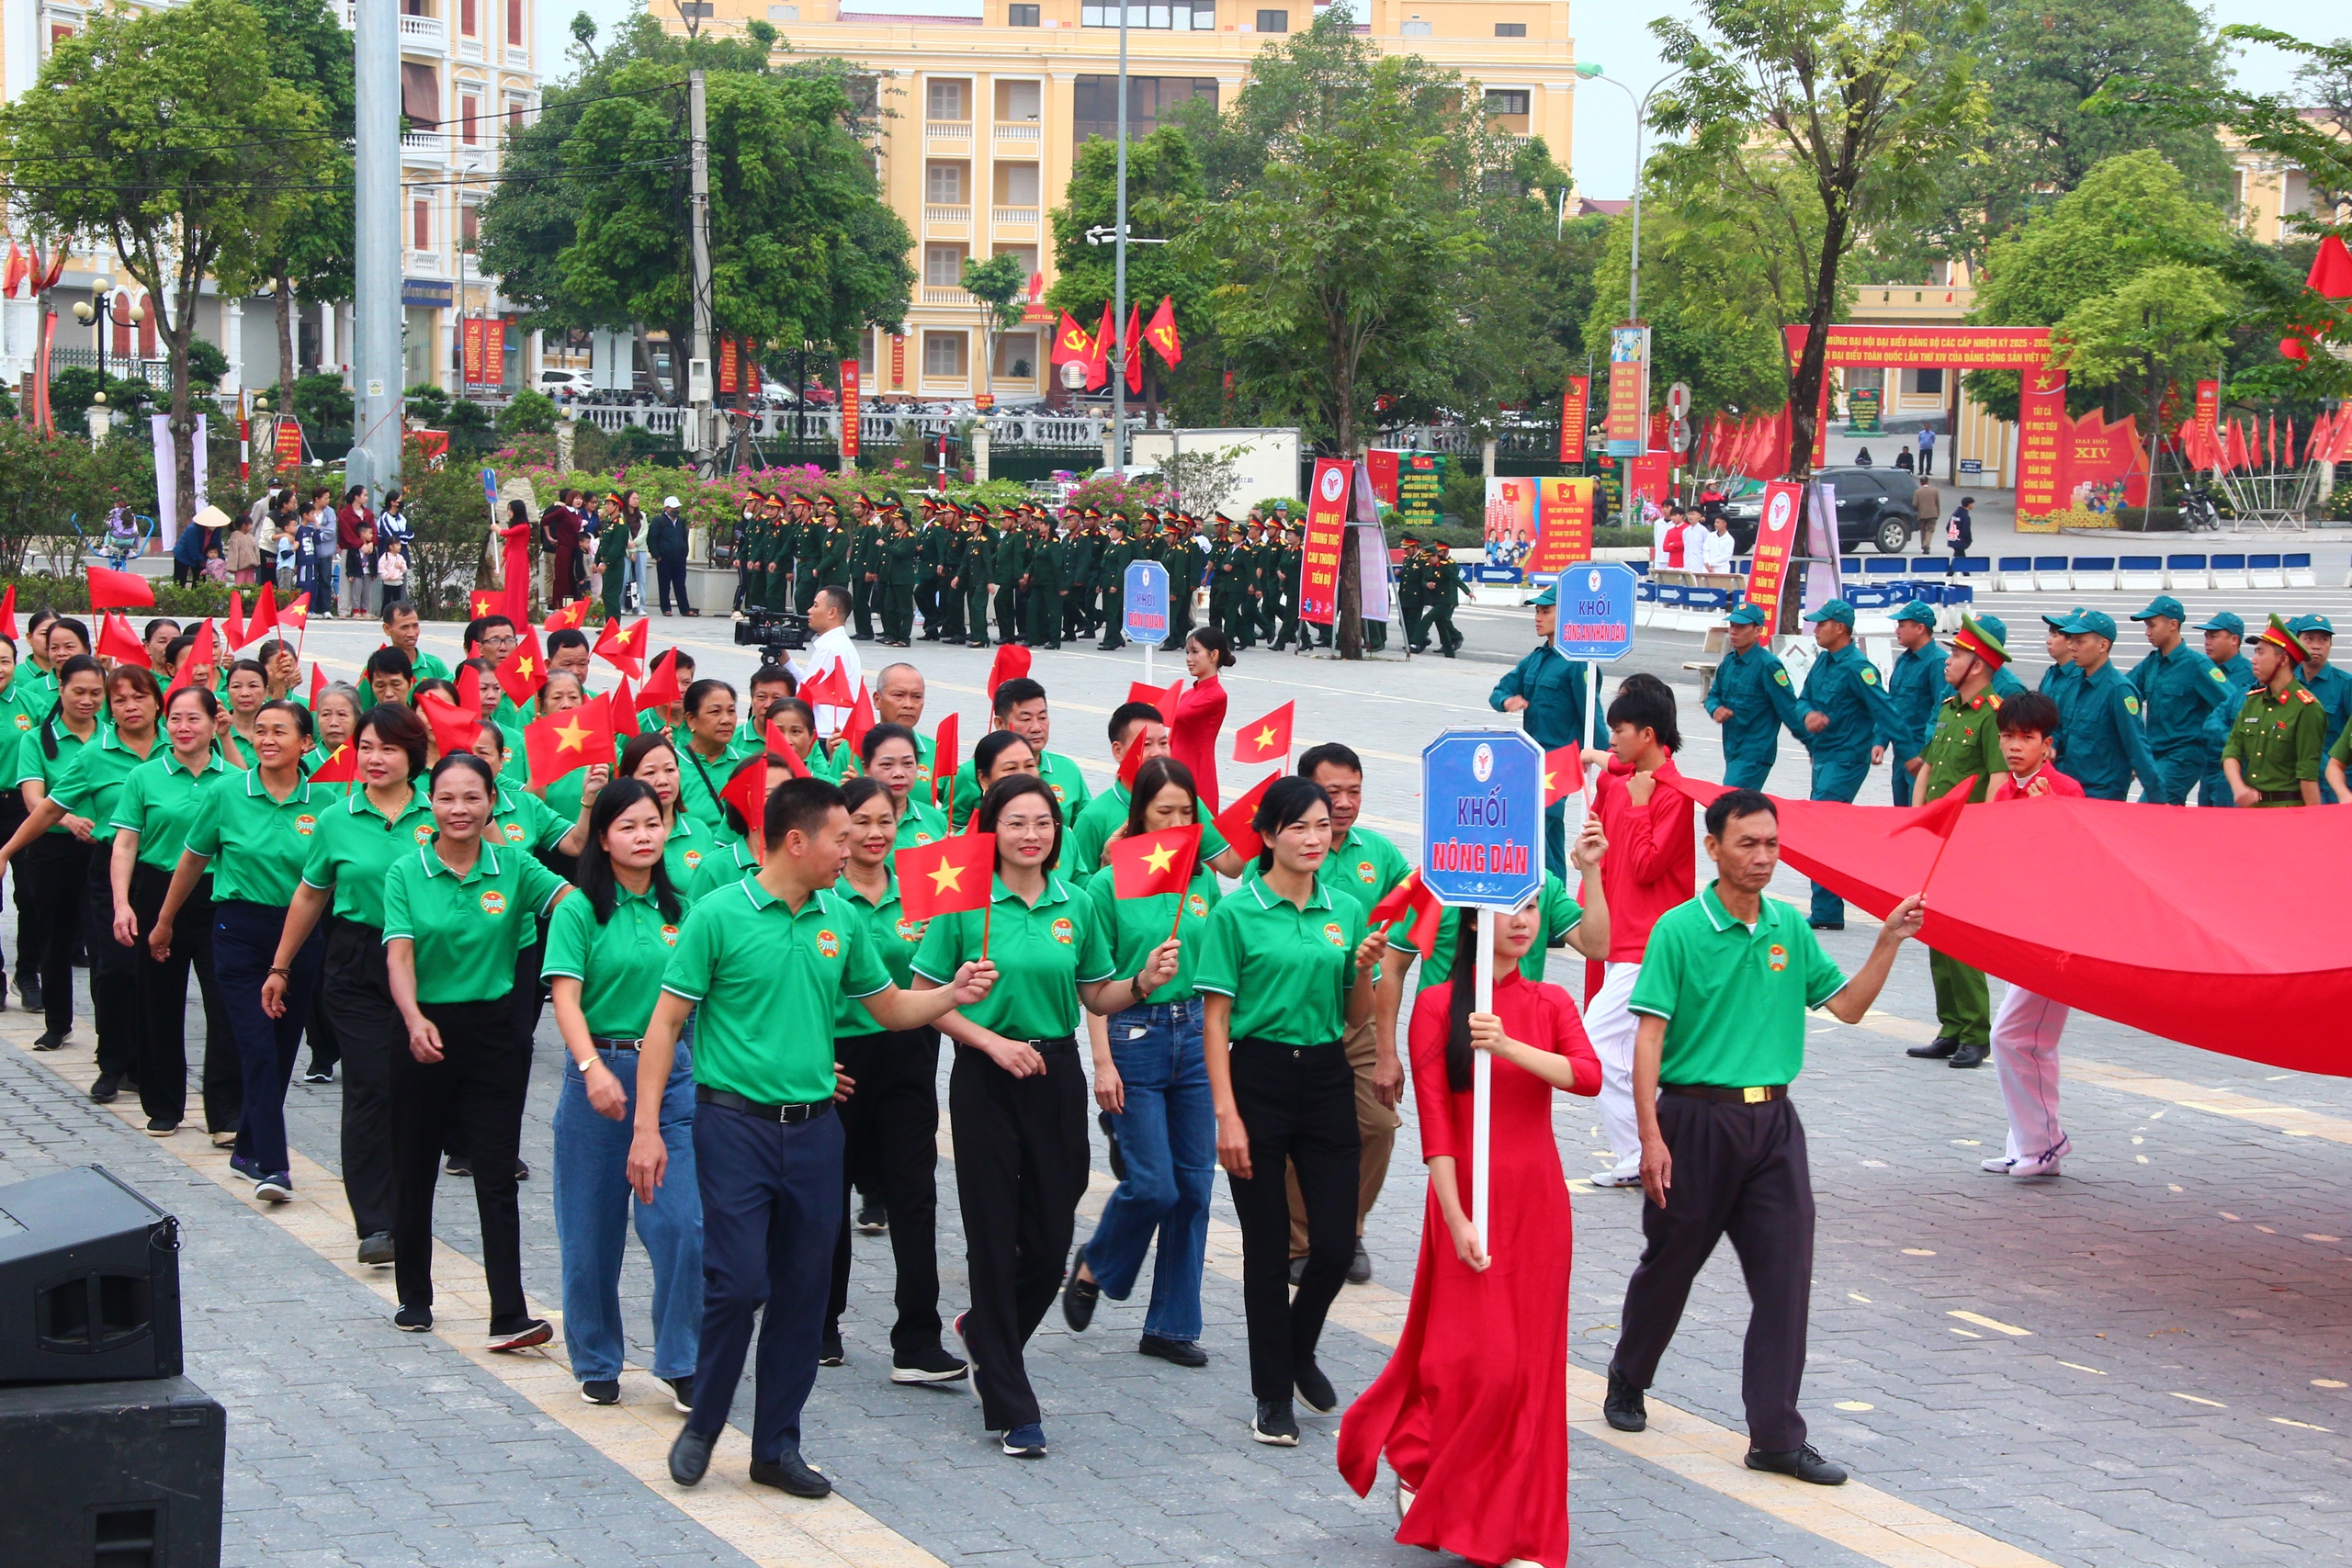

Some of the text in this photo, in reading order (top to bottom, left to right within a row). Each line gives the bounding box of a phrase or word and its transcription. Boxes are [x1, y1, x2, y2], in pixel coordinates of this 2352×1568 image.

[1826, 334, 1847, 345] MỪNG
[1849, 337, 1860, 347] ĐẠI
[1863, 336, 1874, 348] HỘI
[1877, 337, 1888, 348] ĐẠI
[1891, 334, 1905, 346] BIỂU
[1908, 335, 1928, 347] ĐẢNG
[1929, 337, 1939, 349] BỘ
[1941, 336, 1956, 347] CÁC
[1957, 335, 1972, 347] CẤP
[1973, 337, 1996, 349] NHIỆM
[1999, 337, 2007, 347] KỲ
[2010, 339, 2027, 347] 2025
[1832, 351, 1843, 362] ĐẠI
[1846, 348, 1861, 360] BIỂU
[1864, 350, 1882, 361] TOÀN
[1883, 350, 1903, 362] QUỐC
[1905, 350, 1918, 361] LẦN
[1920, 351, 1934, 361] THỨ
[1935, 353, 1946, 362] XIV
[1949, 351, 1962, 362] CỦA
[1964, 351, 1984, 362] ĐẢNG
[1986, 352, 2005, 364] CỘNG
[2007, 351, 2022, 362] SẢN
[2024, 352, 2039, 364] VIỆT
[2041, 354, 2052, 362] NA
[2075, 447, 2110, 457] XIV
[1316, 512, 1340, 525] ĐOÀN KẾT
[1310, 532, 1340, 548] TRUNG THỰC
[1307, 552, 1337, 568] CAO THƯỢNG
[1312, 570, 1331, 588] TIẾN BỘ
[1578, 592, 1611, 616] KHỐI
[1128, 609, 1165, 630] DÂN QUÂN
[1564, 620, 1626, 642] CÔNG AN NHÂN DÂN
[1457, 784, 1508, 827] KHỐI
[1432, 837, 1528, 875] NÔNG DÂN
